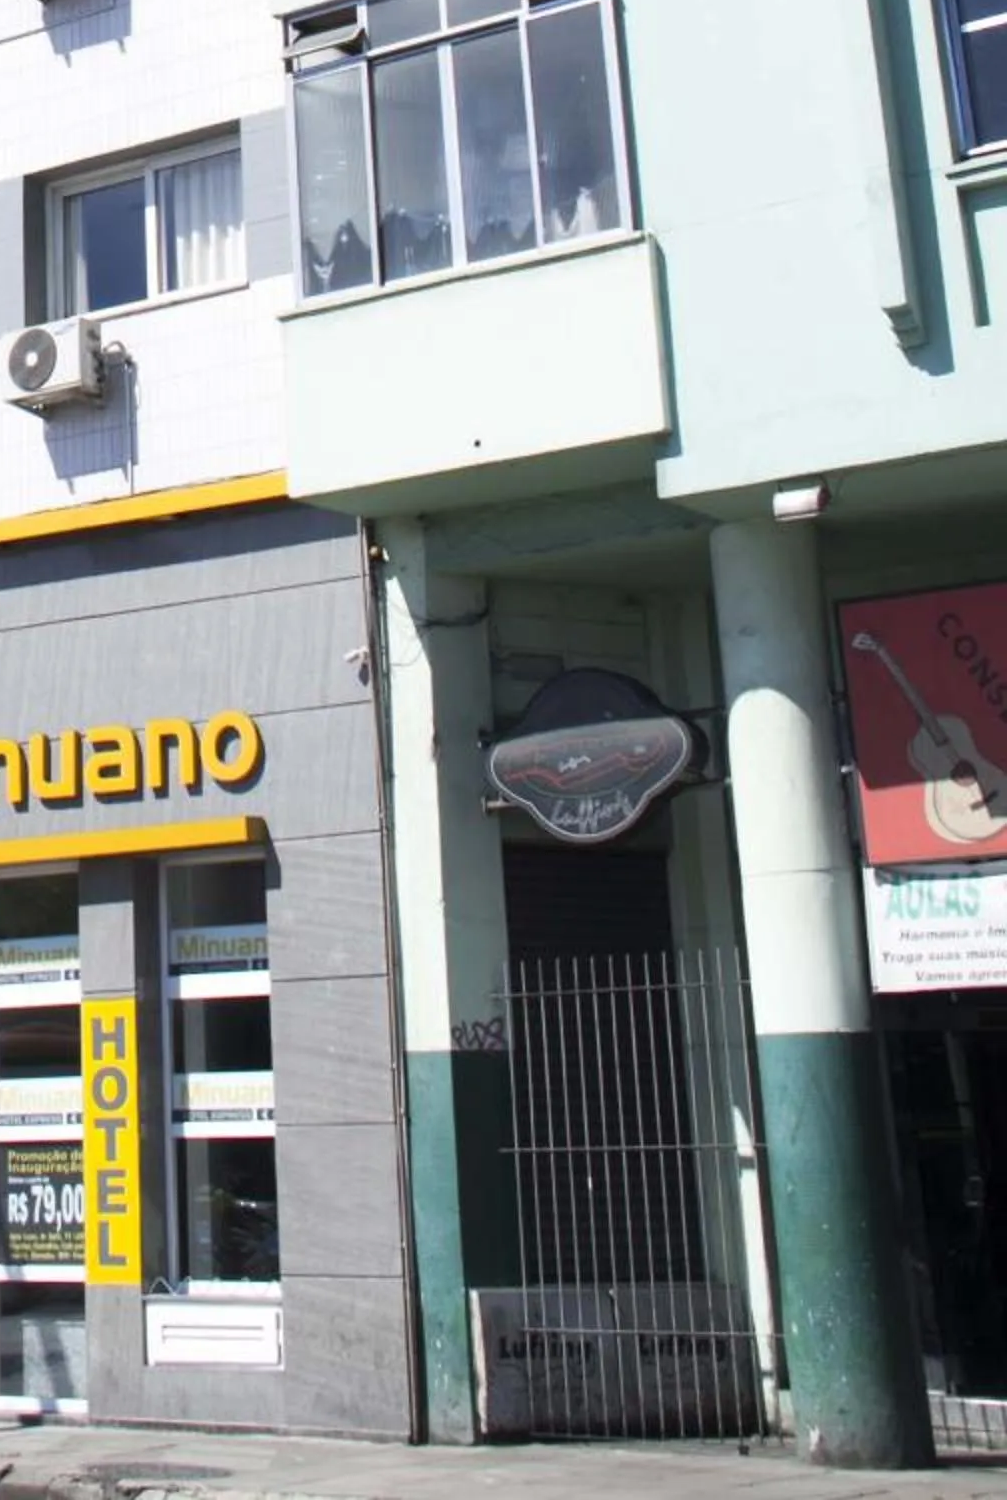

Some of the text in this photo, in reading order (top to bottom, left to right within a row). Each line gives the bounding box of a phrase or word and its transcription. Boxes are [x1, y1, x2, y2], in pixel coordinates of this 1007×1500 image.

[938, 612, 1007, 723] CONS
[885, 870, 980, 920] AULAS
[8, 1149, 69, 1163] Promoção
[90, 1017, 128, 1267] HOTEL
[8, 1184, 85, 1233] R$ 79,00
